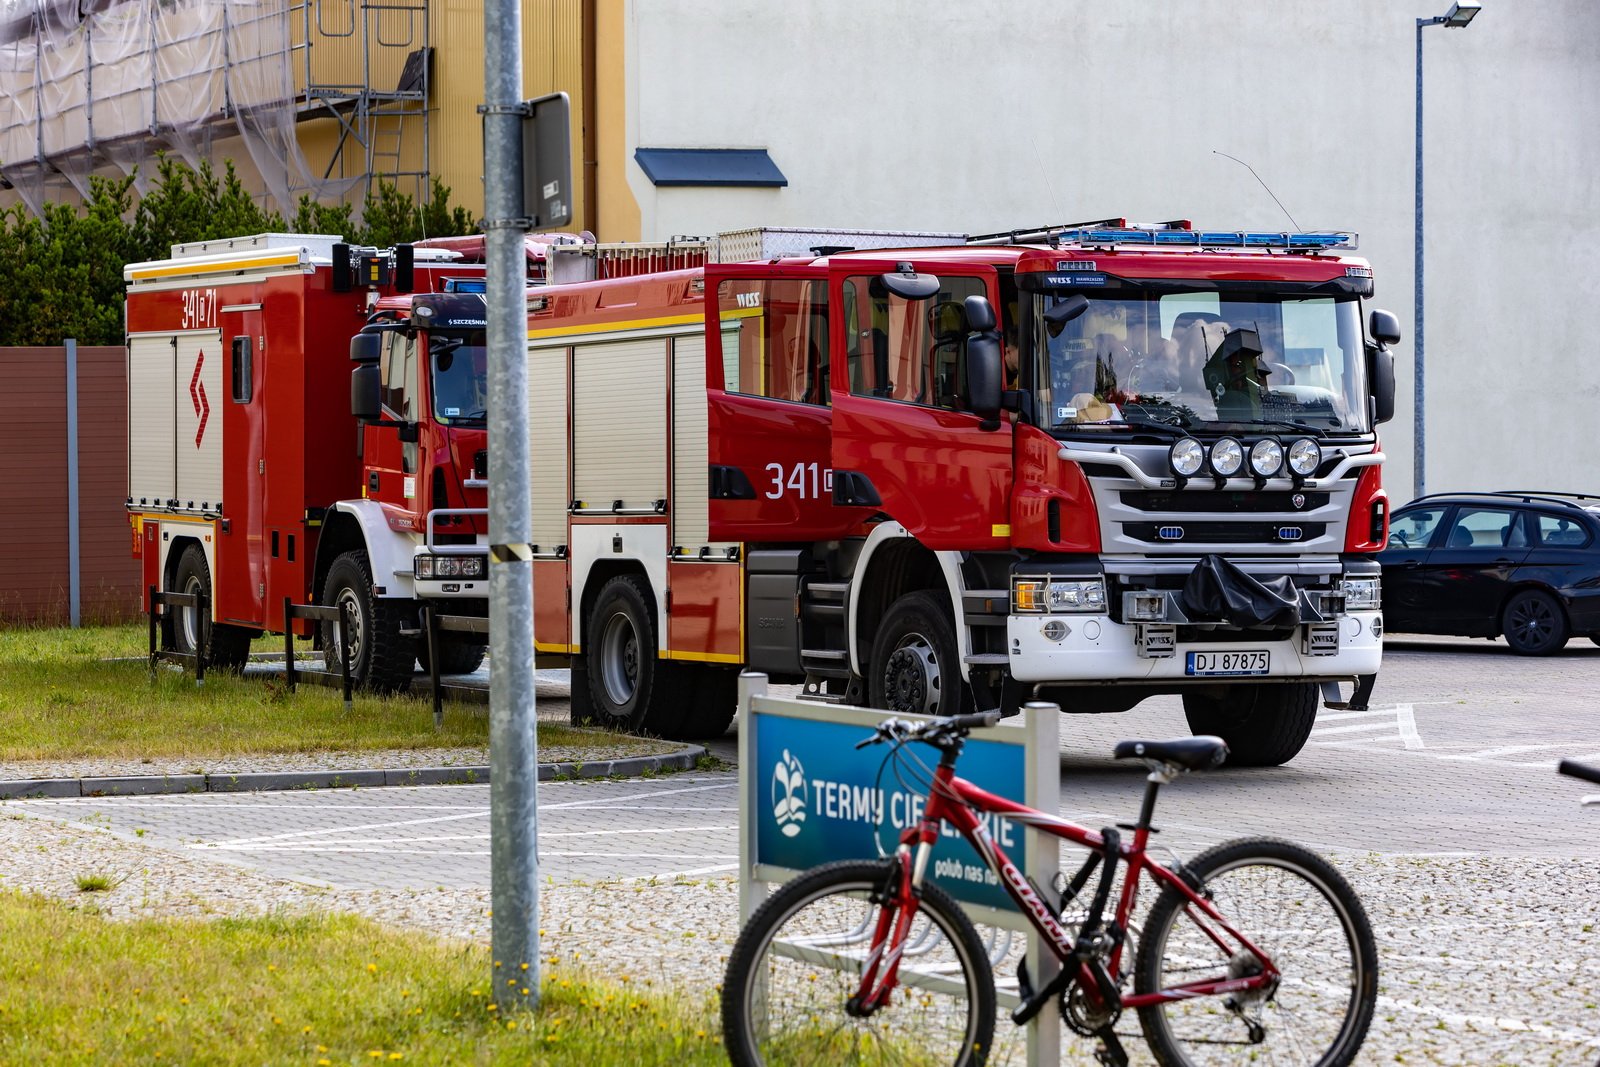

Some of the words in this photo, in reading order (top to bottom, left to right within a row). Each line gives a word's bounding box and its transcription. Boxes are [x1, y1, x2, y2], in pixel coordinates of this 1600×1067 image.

[182, 290, 199, 328] 341
[206, 288, 217, 327] 71
[736, 292, 760, 307] WISS
[765, 463, 818, 499] 341
[1196, 654, 1216, 670] DJ
[1222, 653, 1267, 670] 87875
[935, 857, 963, 879] polub
[964, 865, 984, 883] nas
[1002, 863, 1077, 955] GIANT
